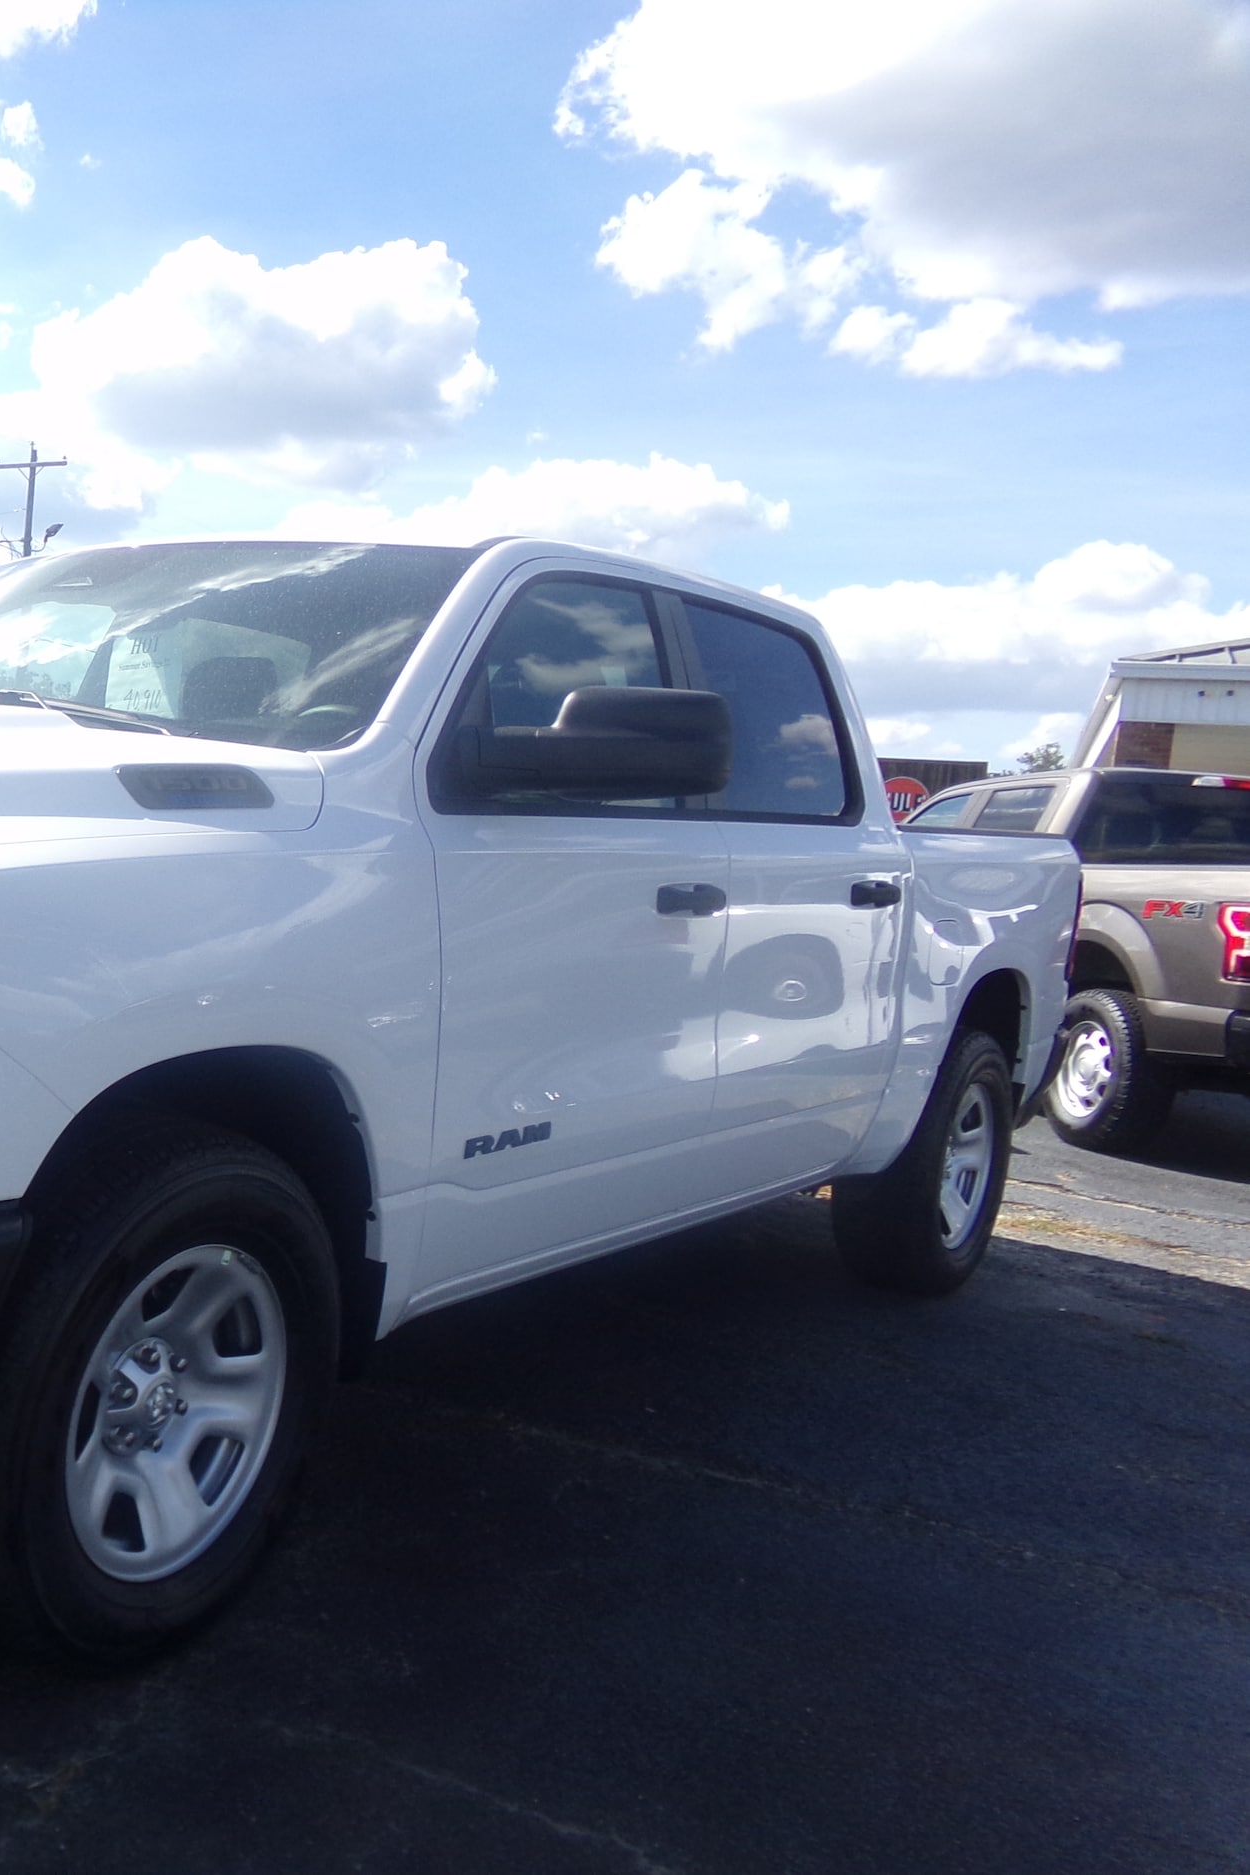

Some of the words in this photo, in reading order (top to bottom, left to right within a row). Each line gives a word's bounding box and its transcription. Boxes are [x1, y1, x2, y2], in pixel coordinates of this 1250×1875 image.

[886, 791, 927, 812] ULF
[1142, 899, 1205, 920] FX4
[463, 1121, 552, 1160] RAM
